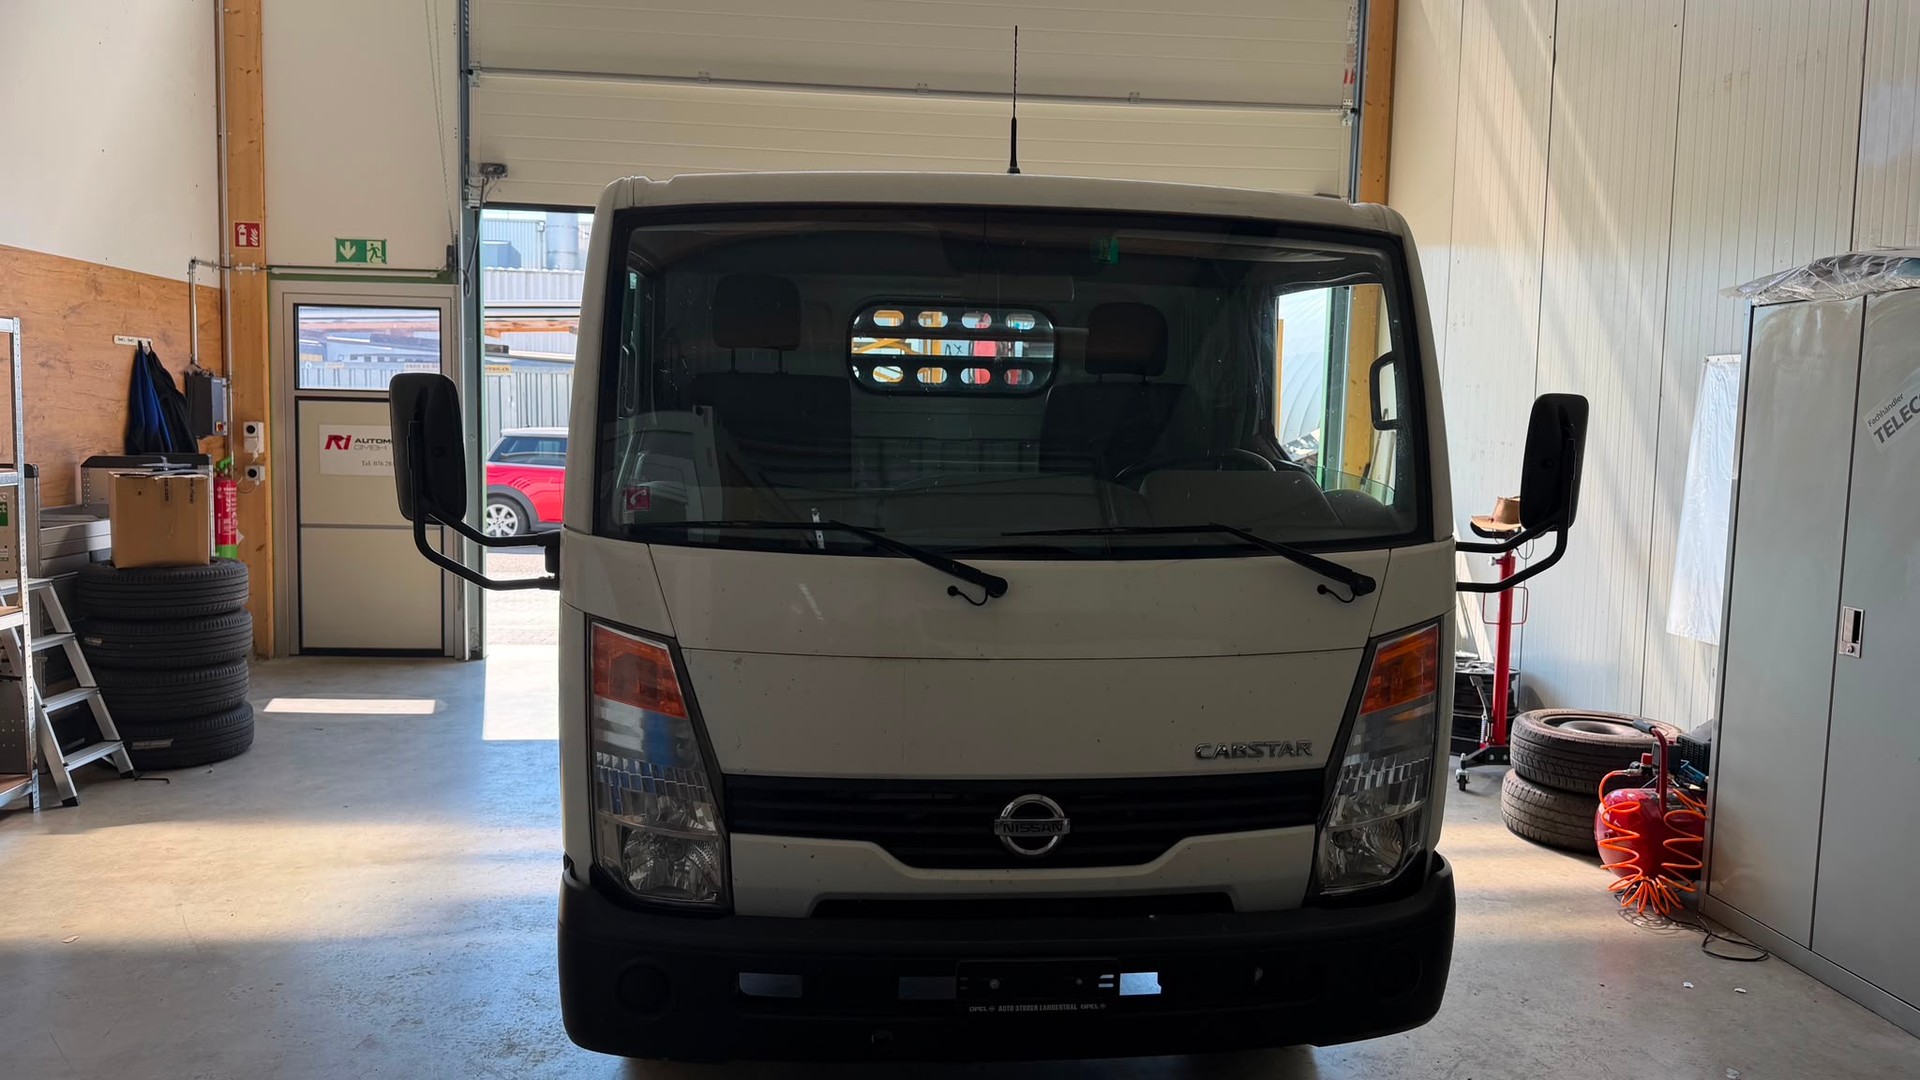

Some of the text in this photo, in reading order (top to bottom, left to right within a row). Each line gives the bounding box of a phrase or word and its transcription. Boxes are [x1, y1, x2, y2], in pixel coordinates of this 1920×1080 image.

[1867, 393, 1904, 427] Fachhändler
[1873, 394, 1920, 444] TELEC
[1195, 739, 1313, 760] CABSTAR
[1003, 822, 1063, 833] NISSAN
